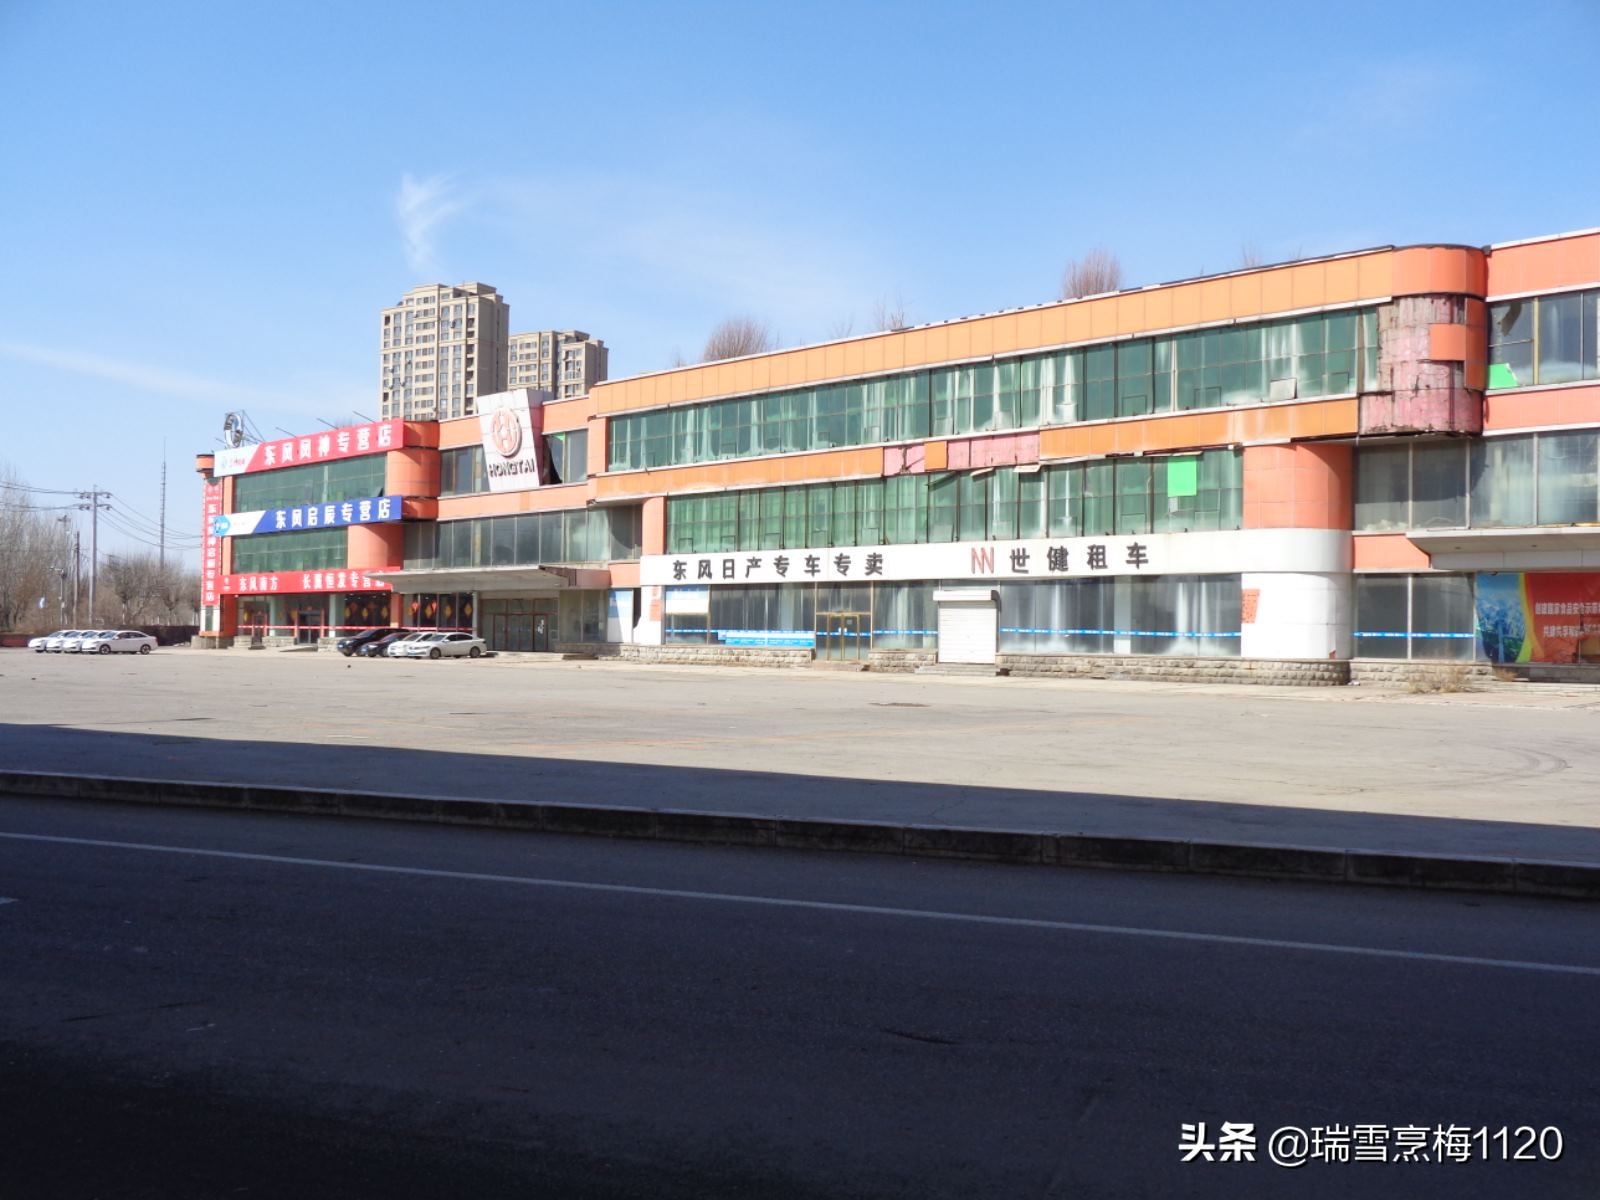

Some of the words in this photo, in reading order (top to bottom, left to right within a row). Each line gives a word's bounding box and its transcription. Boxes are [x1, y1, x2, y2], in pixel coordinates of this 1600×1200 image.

[264, 424, 392, 466] 东风风神专营店
[489, 458, 535, 478] HONGTAI
[275, 498, 391, 529] 东风启辰专营店
[673, 552, 884, 581] 东风日产专车专卖
[1009, 542, 1149, 574] 世健租车
